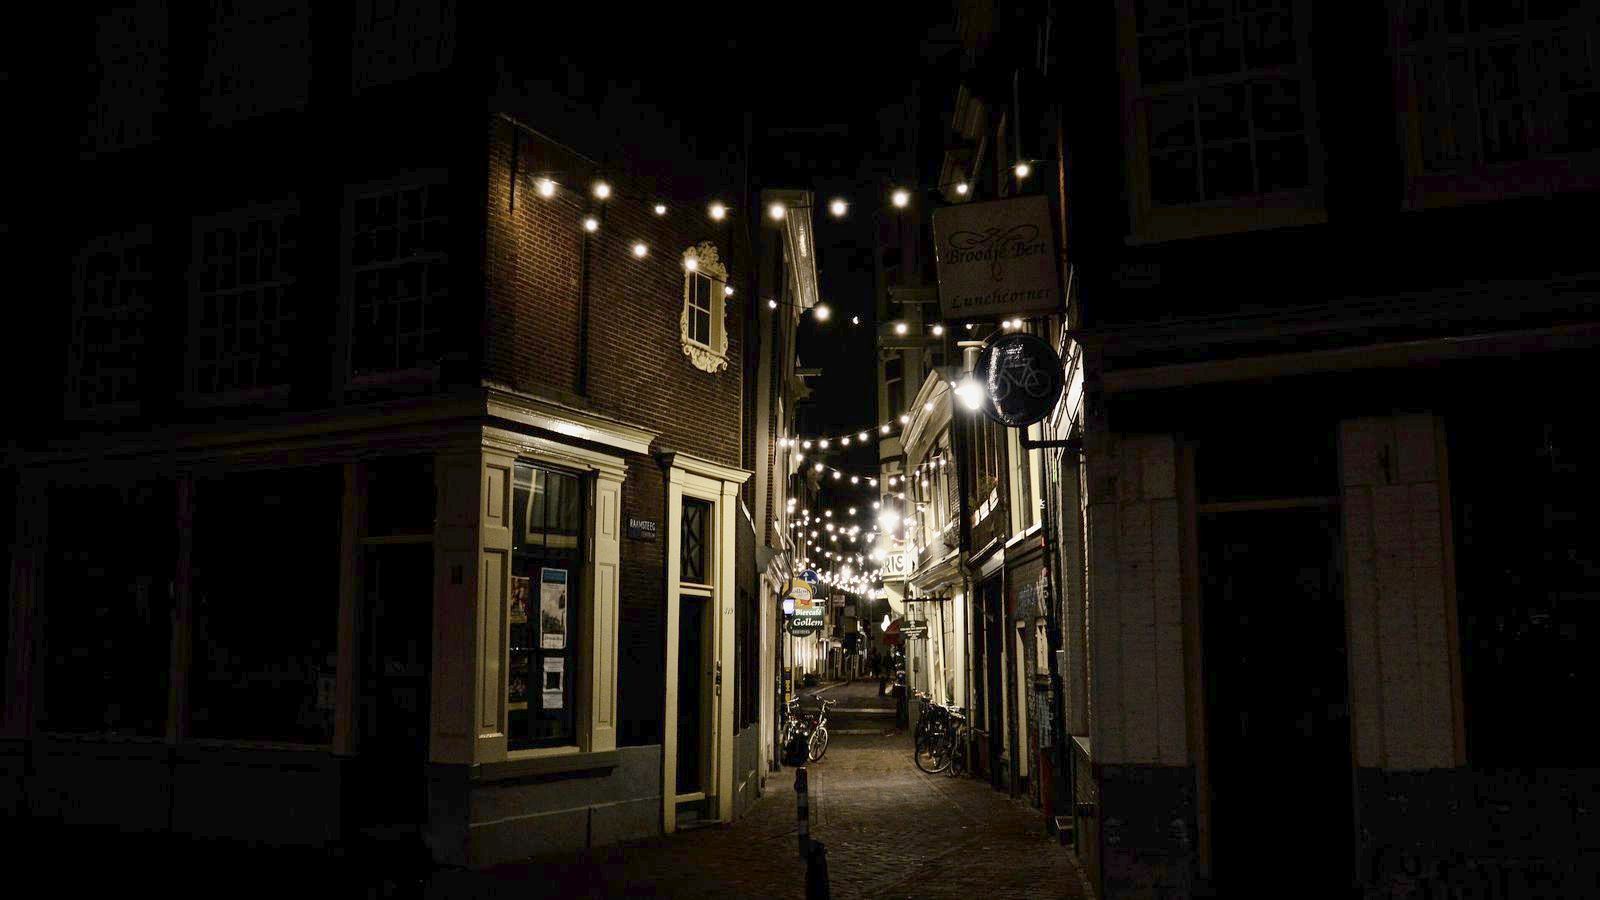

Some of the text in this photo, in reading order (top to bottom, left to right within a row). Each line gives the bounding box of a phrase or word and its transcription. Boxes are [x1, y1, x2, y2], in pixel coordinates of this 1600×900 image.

[944, 239, 1047, 268] Broodje Bert
[951, 287, 1050, 309] Lunchcorner
[629, 518, 656, 531] RAAMSTEEG
[793, 617, 824, 627] Gollem
